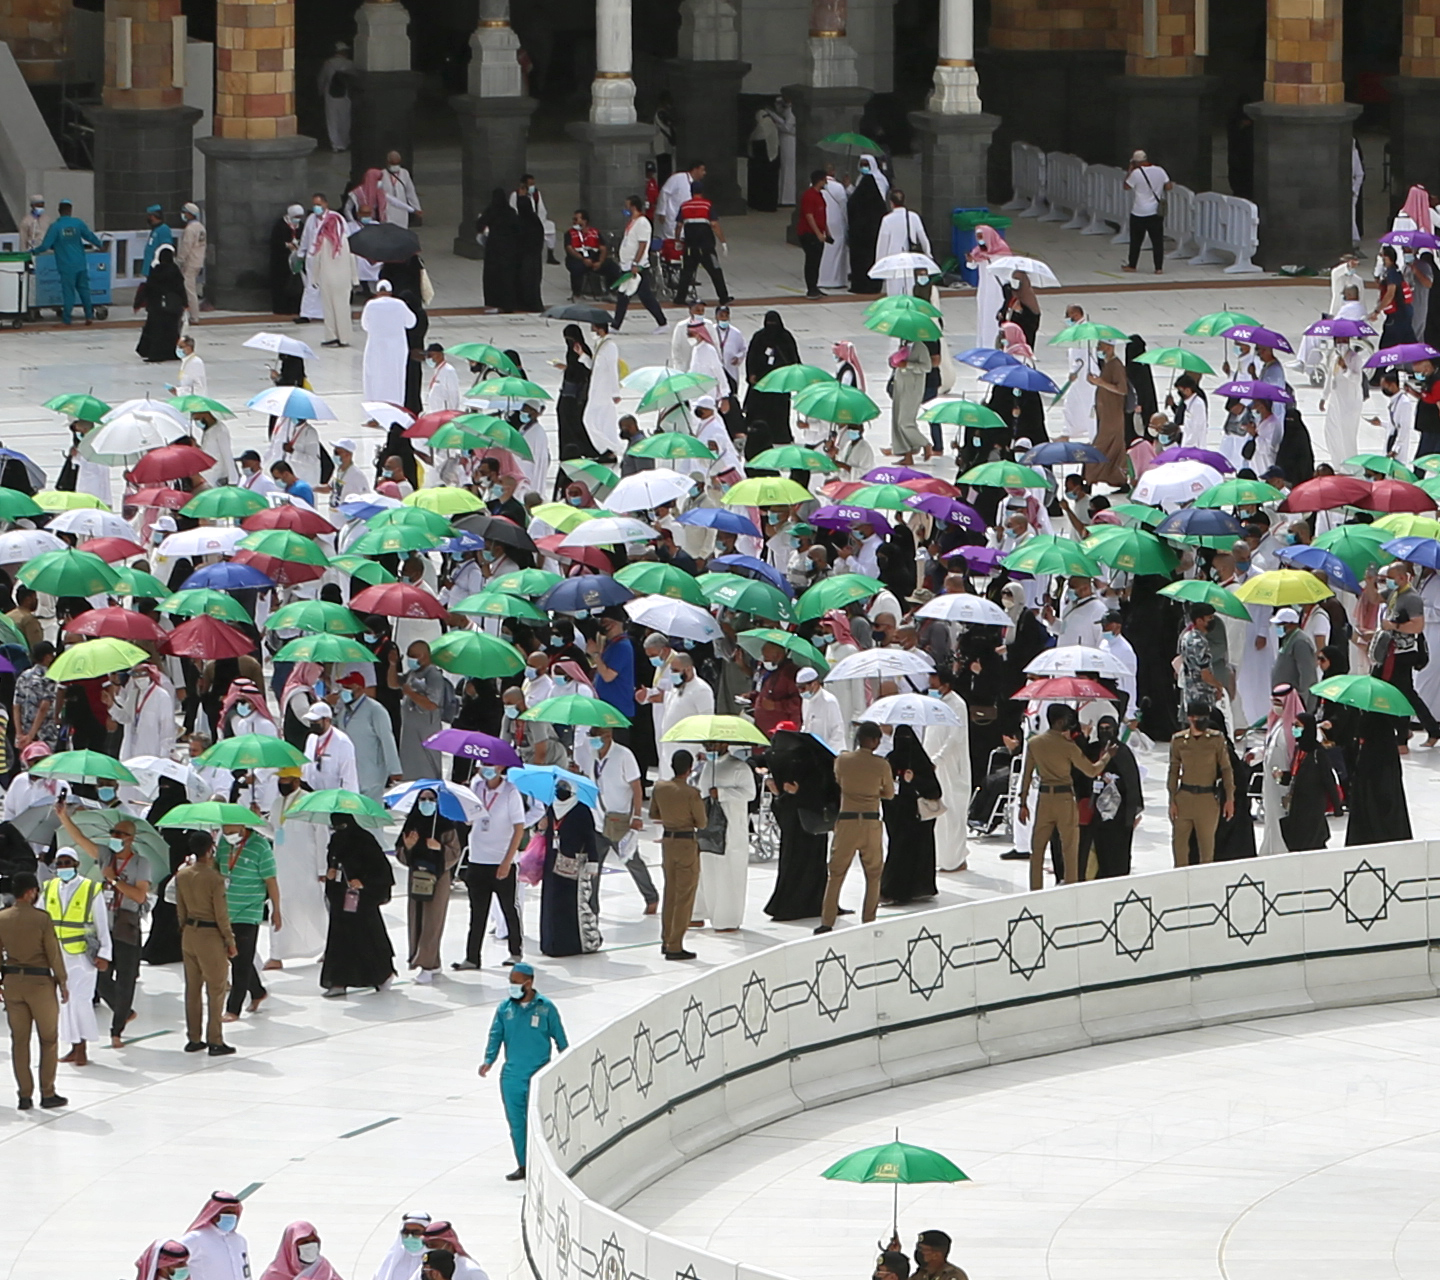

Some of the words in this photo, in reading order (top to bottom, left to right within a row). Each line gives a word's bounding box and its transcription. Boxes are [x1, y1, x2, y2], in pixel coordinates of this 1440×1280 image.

[838, 508, 861, 519] stc
[951, 509, 972, 524] stc
[464, 743, 489, 757] stc
